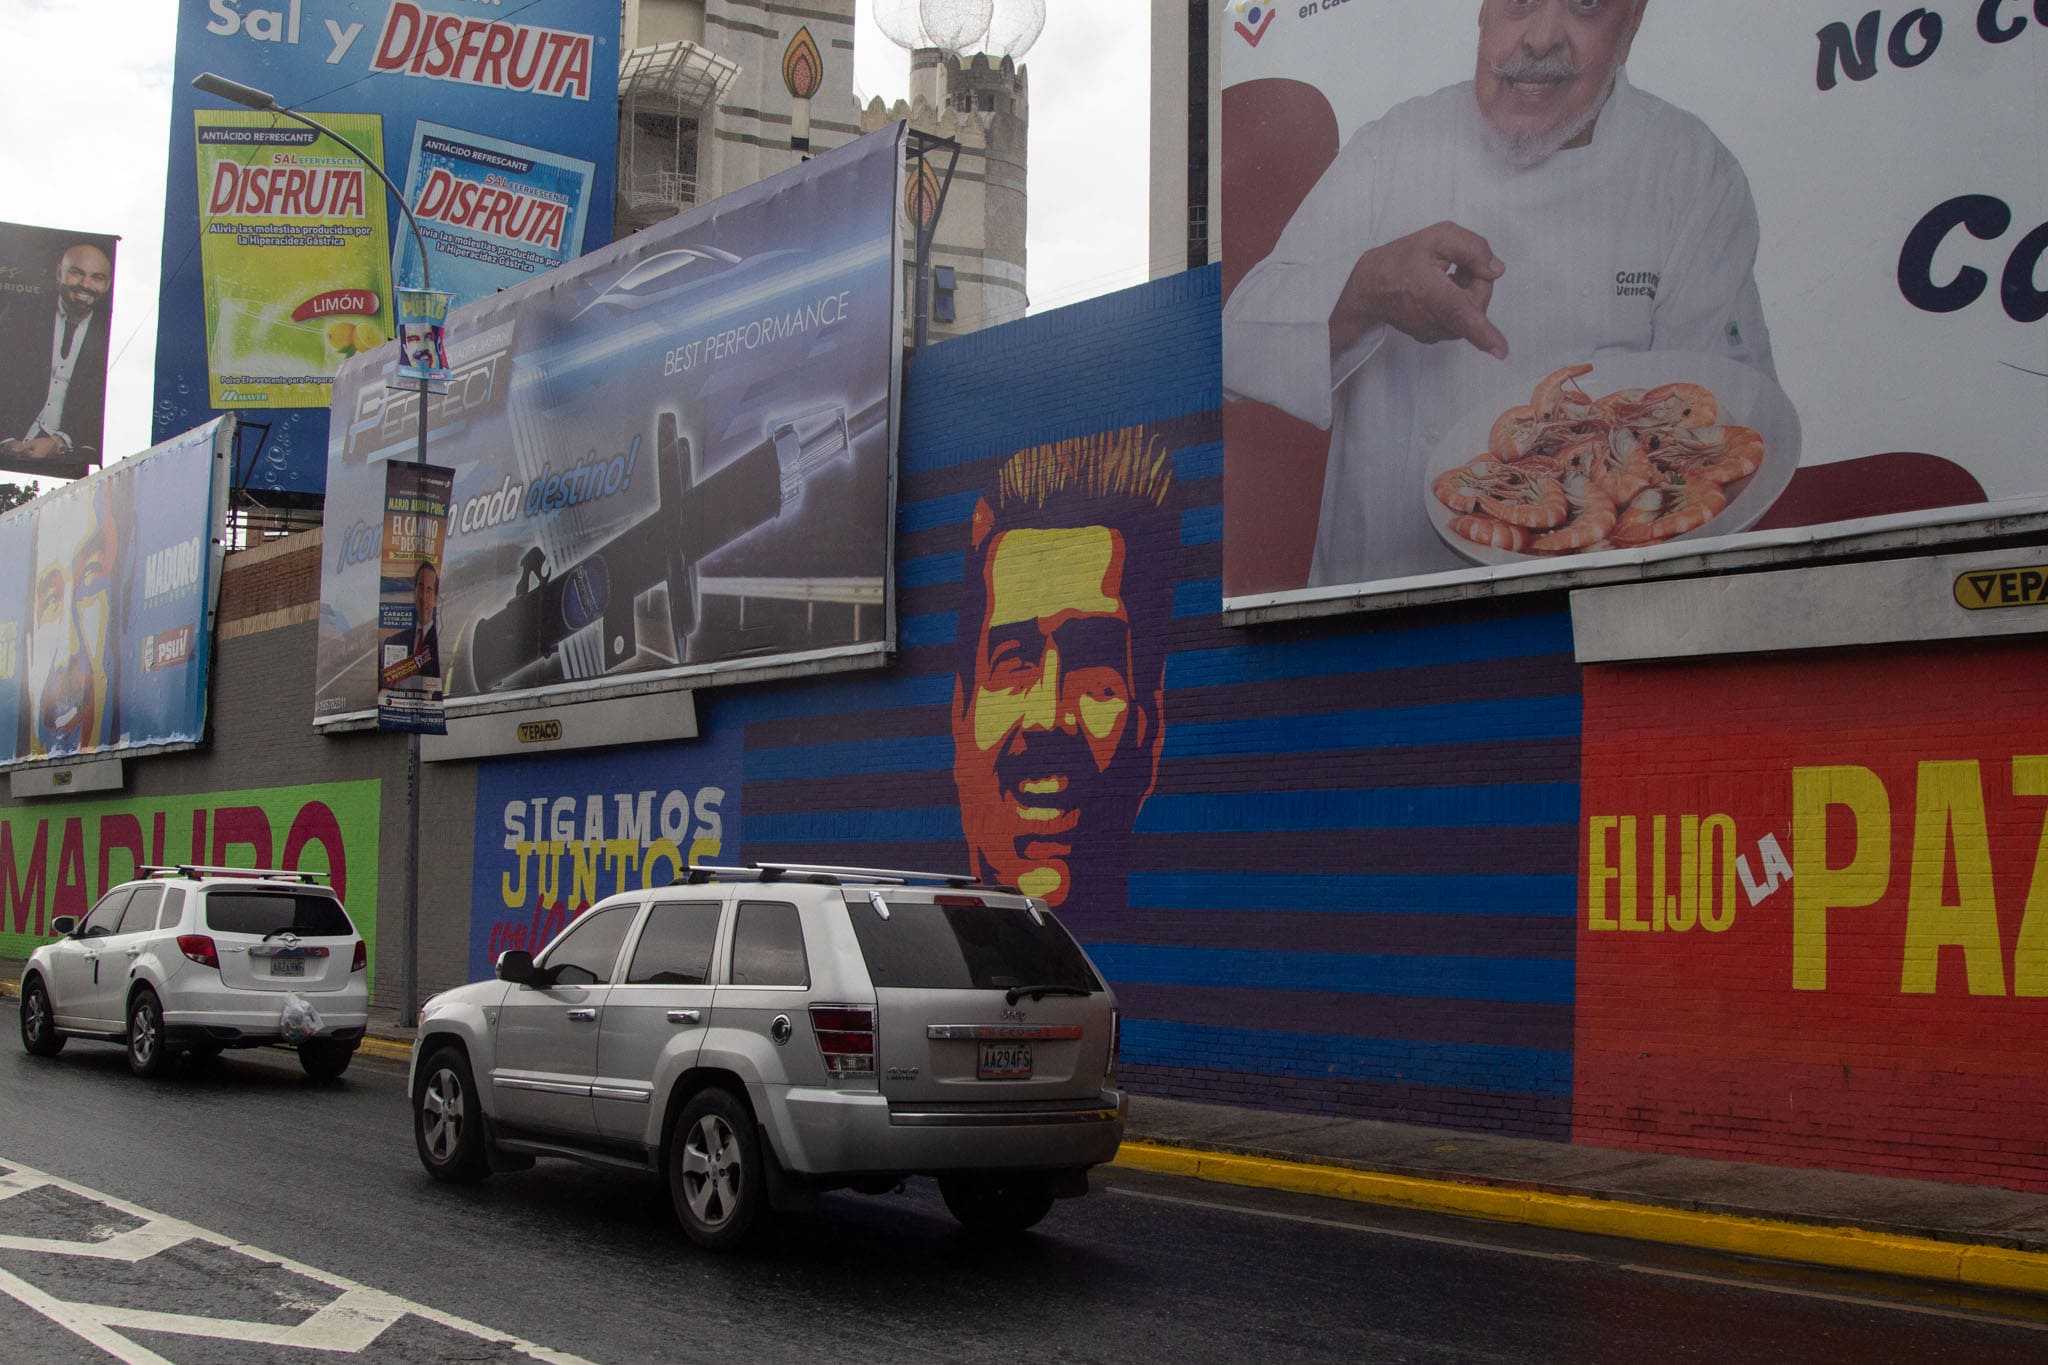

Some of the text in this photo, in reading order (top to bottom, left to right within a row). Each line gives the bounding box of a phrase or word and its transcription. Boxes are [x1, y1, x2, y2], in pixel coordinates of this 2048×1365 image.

[1299, 2, 1317, 18] en
[206, 0, 591, 98] Sal y DISFRUTA
[1815, 7, 1943, 91] NO
[202, 130, 314, 143] ANTIÁCIDO REFRESCANTE
[274, 153, 363, 166] SAL EFERVESCENTE
[425, 139, 529, 172] ANTIÁCIDO REFRESCANTE
[209, 162, 364, 216] DISFRUTA
[486, 174, 569, 203] SAL EFERVESCENTE
[416, 169, 565, 249] DISFRUTA
[210, 223, 372, 237] Alivia las molestias producidas por
[238, 235, 345, 247] la Hiperacidez Gástrica
[436, 241, 535, 274] la Hiperacidez Gástrica
[439, 230, 454, 242] las
[454, 234, 497, 252] molestias
[498, 246, 546, 265] producidas
[546, 256, 561, 268] por
[313, 295, 364, 314] LIMÓN
[664, 290, 849, 377] BEST PERFORMANCE
[461, 474, 523, 533] cada
[525, 435, 641, 517] destino!
[388, 497, 409, 511] MARIO
[392, 515, 402, 536] EL
[144, 536, 200, 599] MADURO
[503, 786, 725, 850] SIGAMOS
[0, 800, 347, 938] MADURO
[502, 837, 722, 911] JUNTOS
[1588, 813, 1736, 933] ELIJO
[1735, 832, 1793, 907] LA
[982, 1049, 1030, 1070] AA294FS
